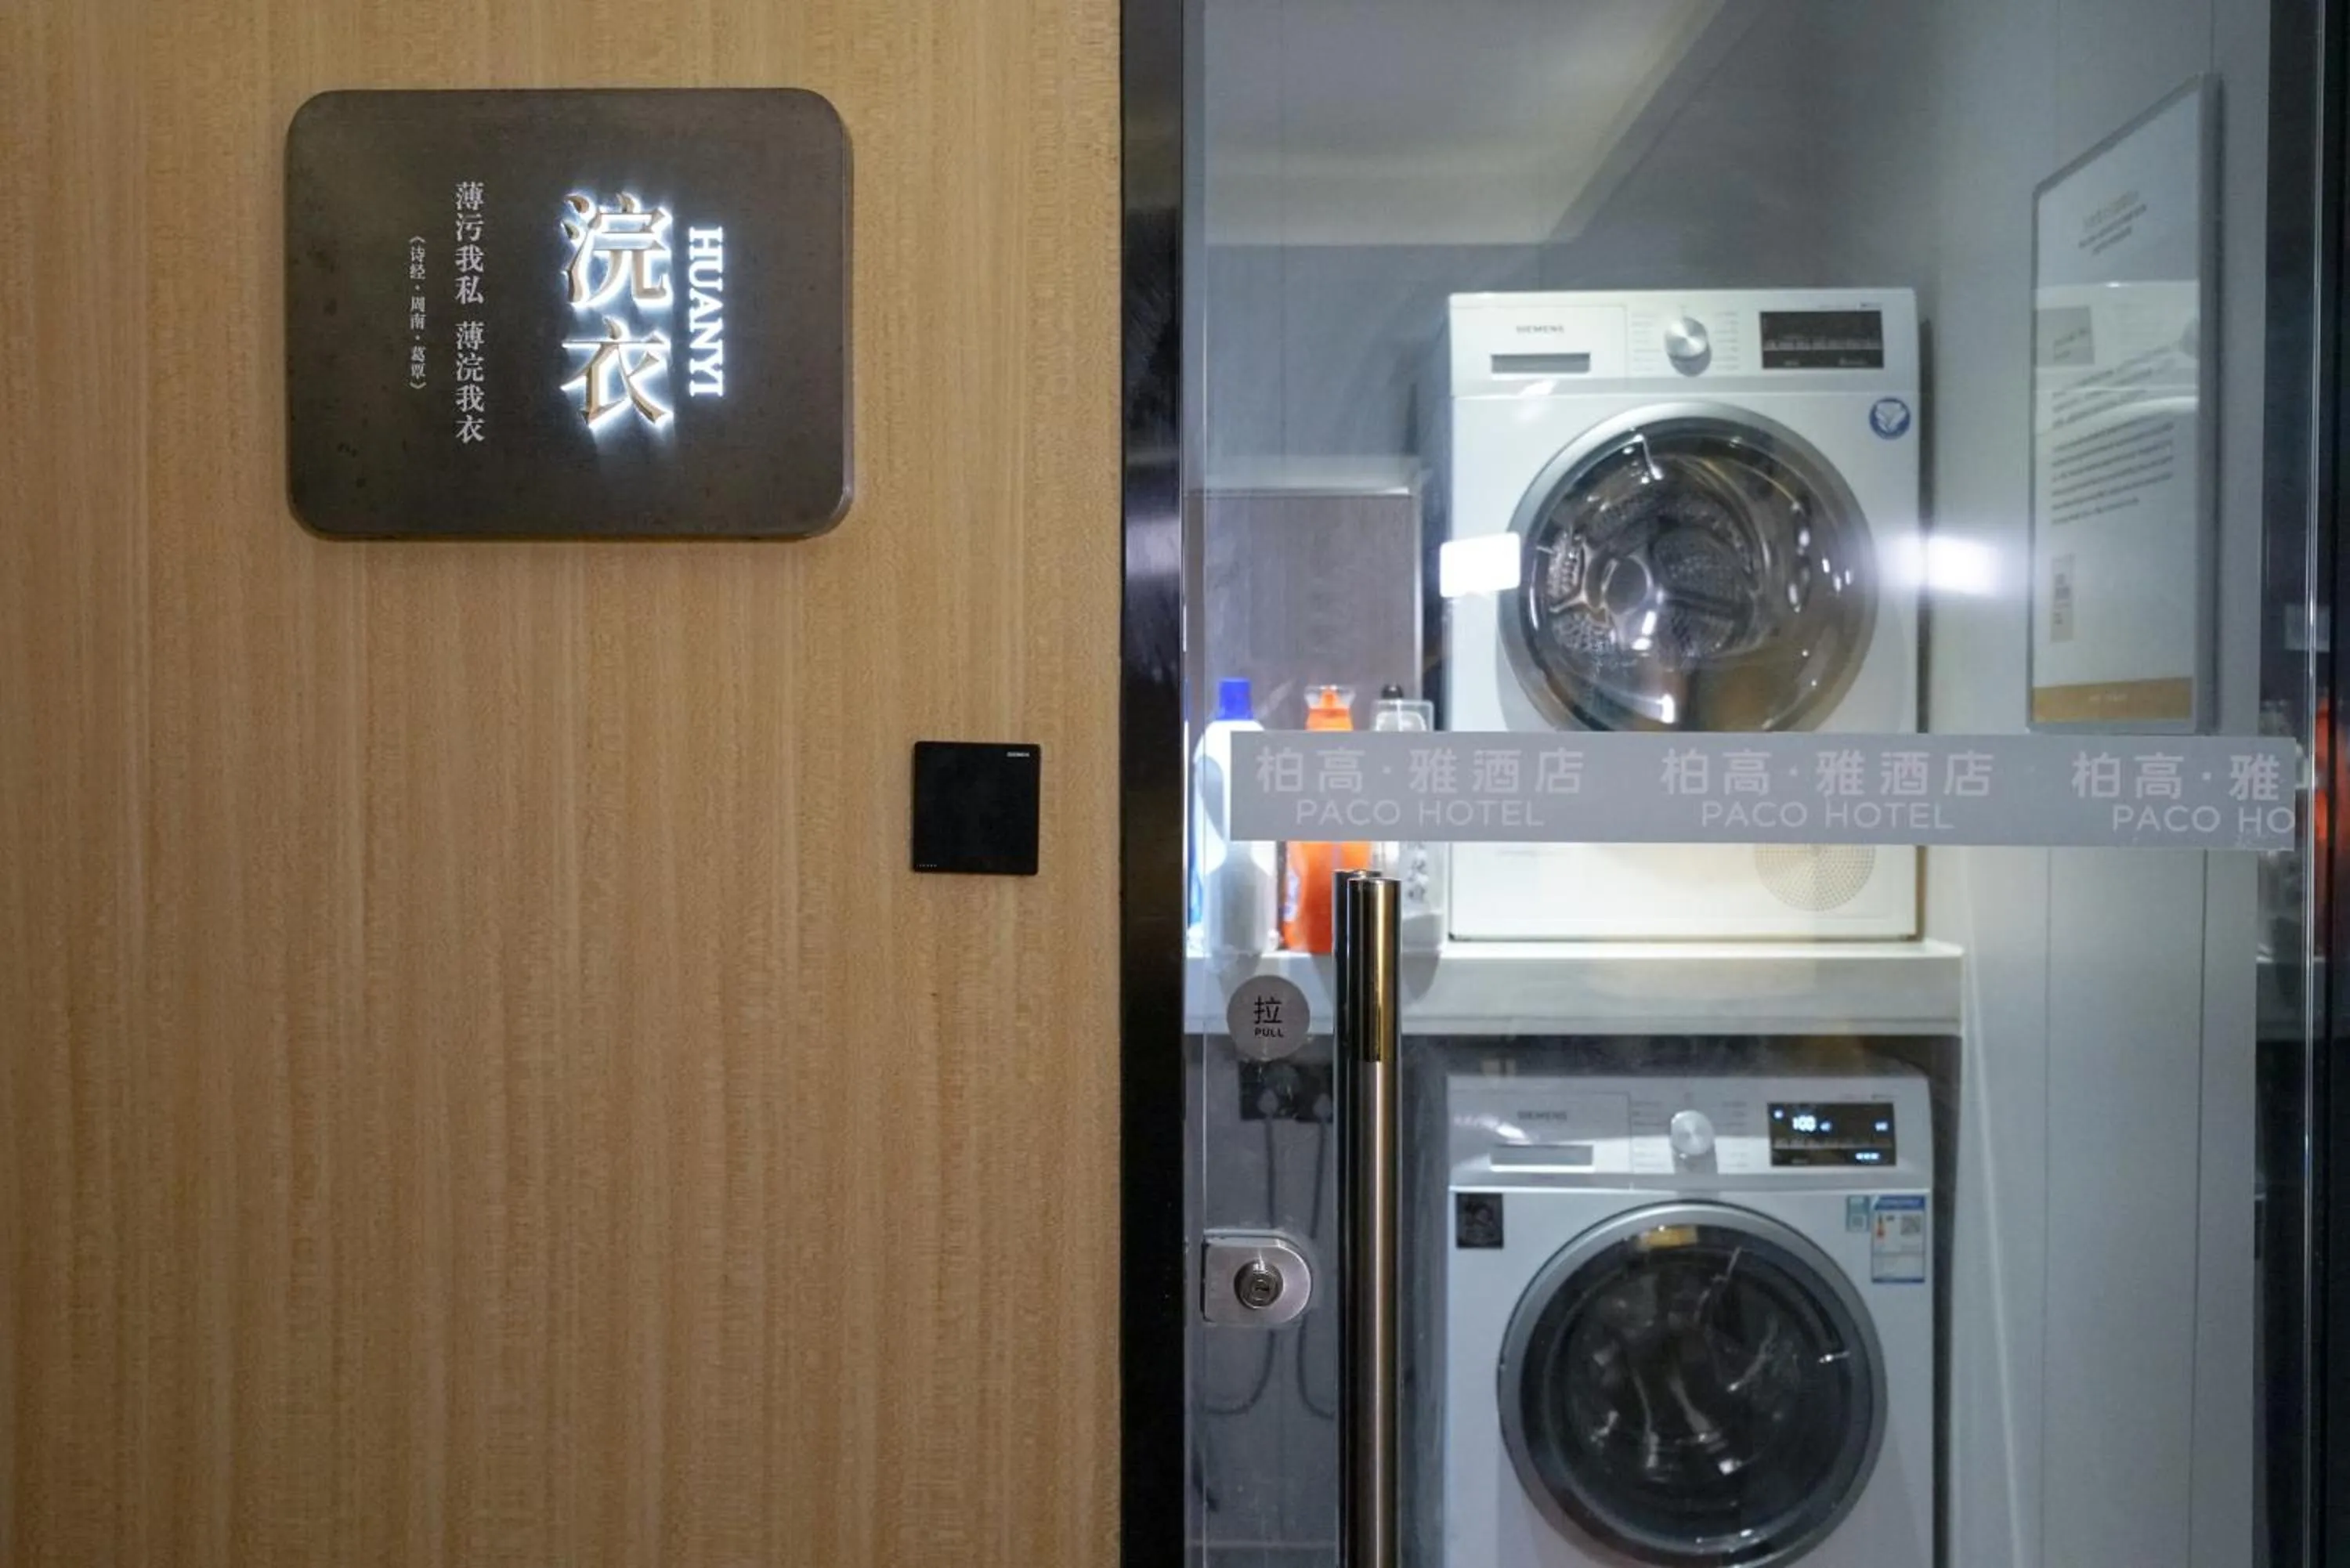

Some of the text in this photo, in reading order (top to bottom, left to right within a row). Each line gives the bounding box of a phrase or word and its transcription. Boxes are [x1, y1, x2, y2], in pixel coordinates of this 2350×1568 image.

[454, 181, 485, 444] 薄污我私 薄浣我衣
[559, 190, 673, 428] 浣衣
[689, 226, 724, 397] HUANYI
[1256, 746, 1584, 794] 柏高·雅酒店
[1660, 748, 1994, 797] 柏高·雅酒店
[2072, 751, 2280, 801] 柏高·雅
[1296, 800, 1546, 827] PACO HOTEL
[1701, 801, 1954, 829] PACO HOTEL
[2113, 804, 2294, 834] PACO HO
[1253, 995, 1282, 1024] 拉
[1254, 1027, 1284, 1038] PULL
